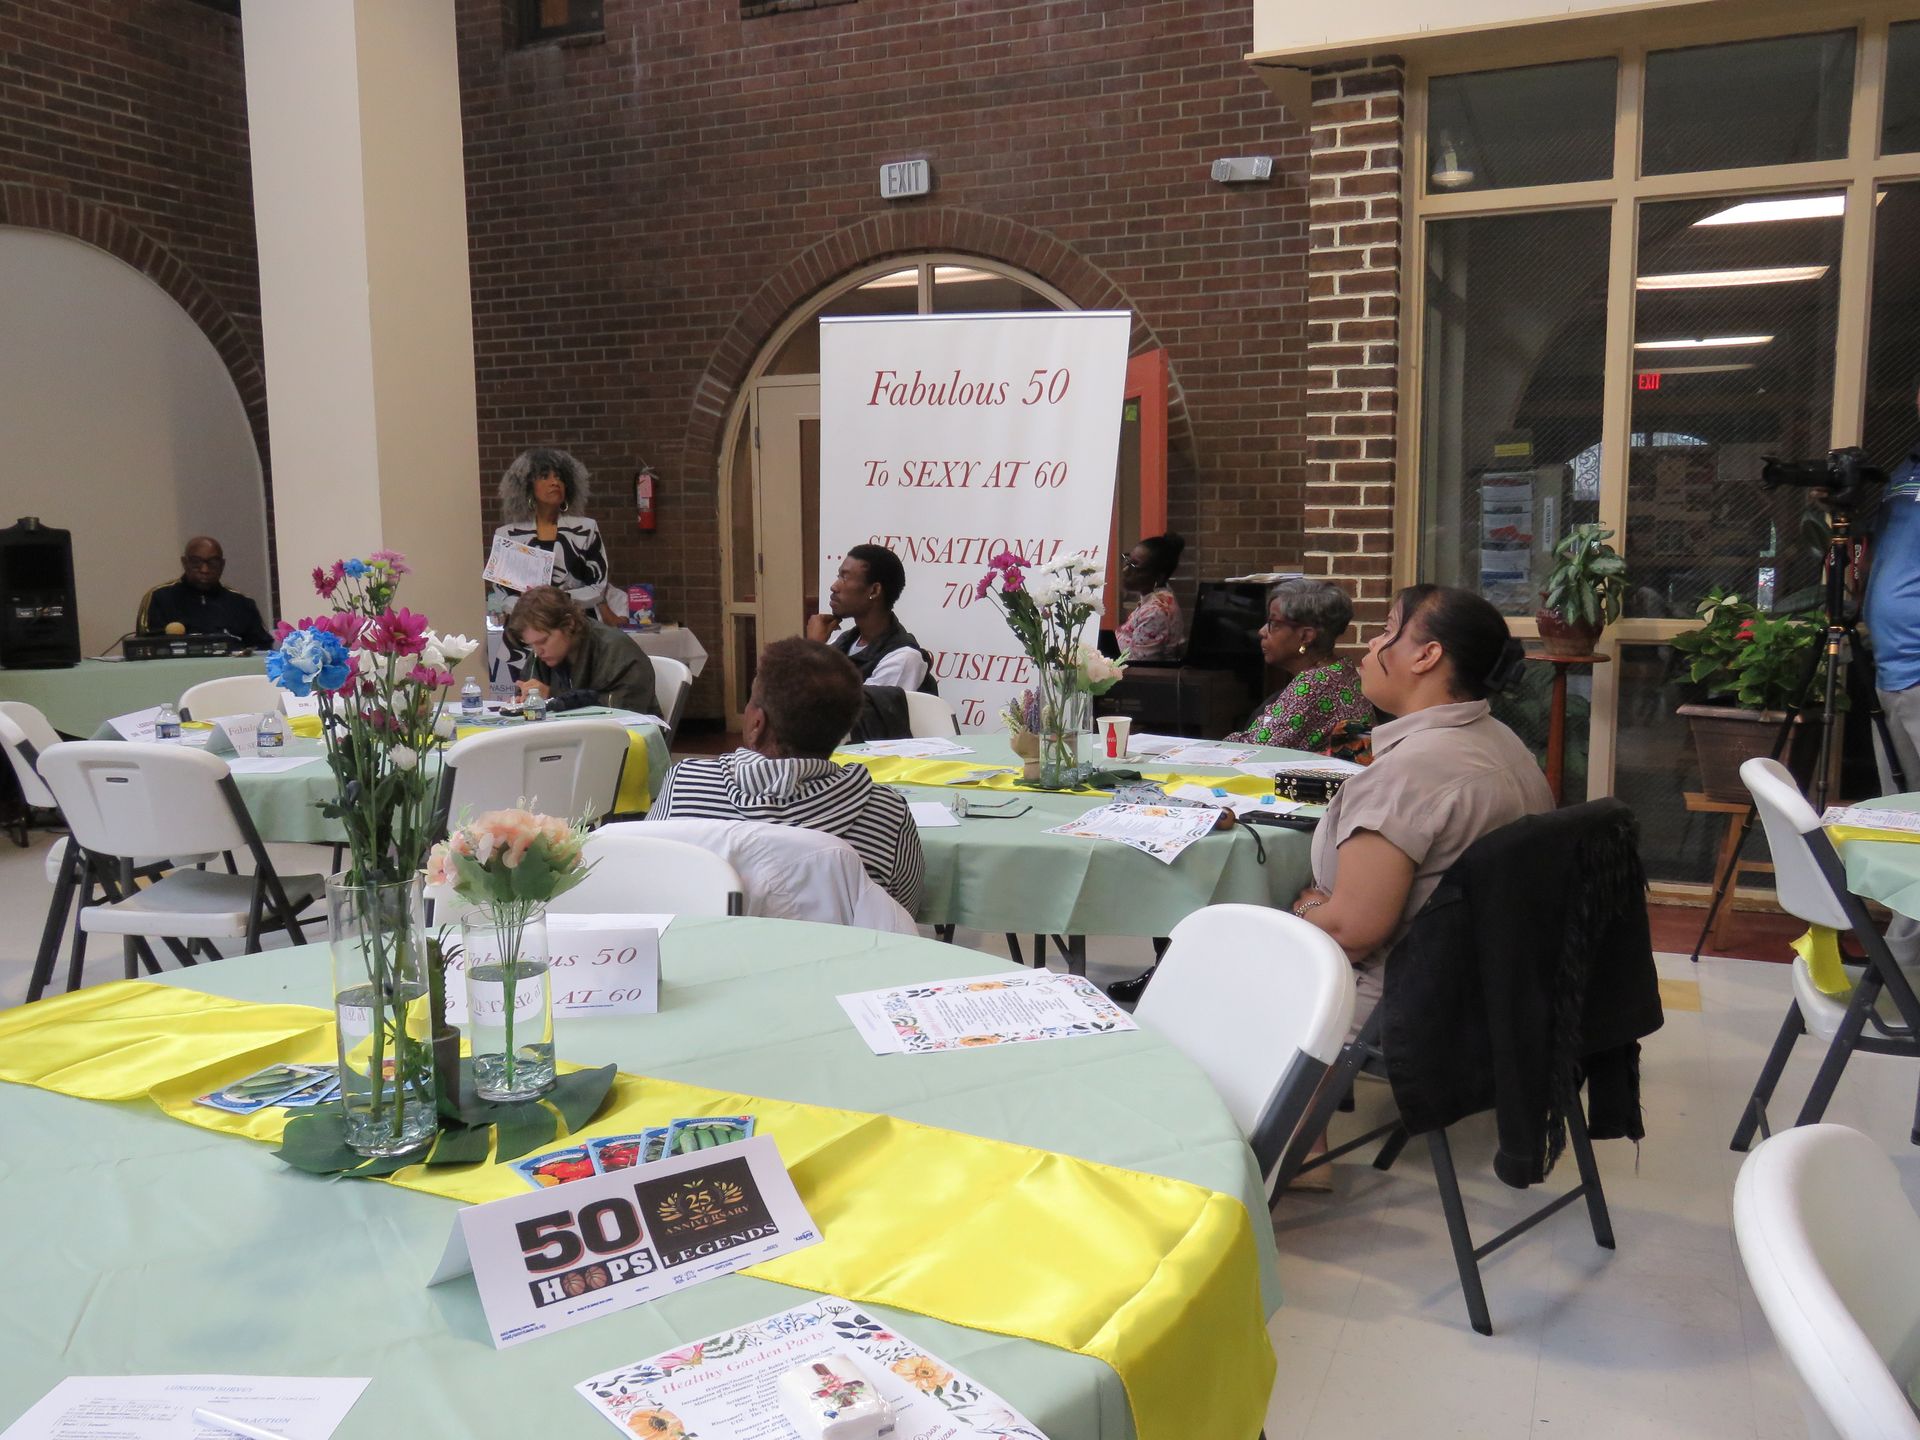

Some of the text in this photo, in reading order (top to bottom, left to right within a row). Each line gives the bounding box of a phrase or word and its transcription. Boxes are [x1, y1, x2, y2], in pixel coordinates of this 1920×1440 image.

[888, 162, 921, 195] EXIT
[867, 368, 1070, 406] Fabulous 50
[1638, 373, 1660, 390] EXIT
[864, 460, 1067, 489] To SEXY AT 60
[942, 582, 974, 610] 70
[961, 699, 985, 727] To
[592, 947, 638, 966] 50
[556, 989, 602, 1005] AT
[608, 988, 642, 1002] 60
[686, 1190, 711, 1210] 25
[664, 1204, 751, 1235] ANNIVERSARY
[515, 1197, 643, 1274] 50
[662, 1221, 778, 1267] LEGENDS
[662, 1331, 825, 1395] Healthy Garden Party
